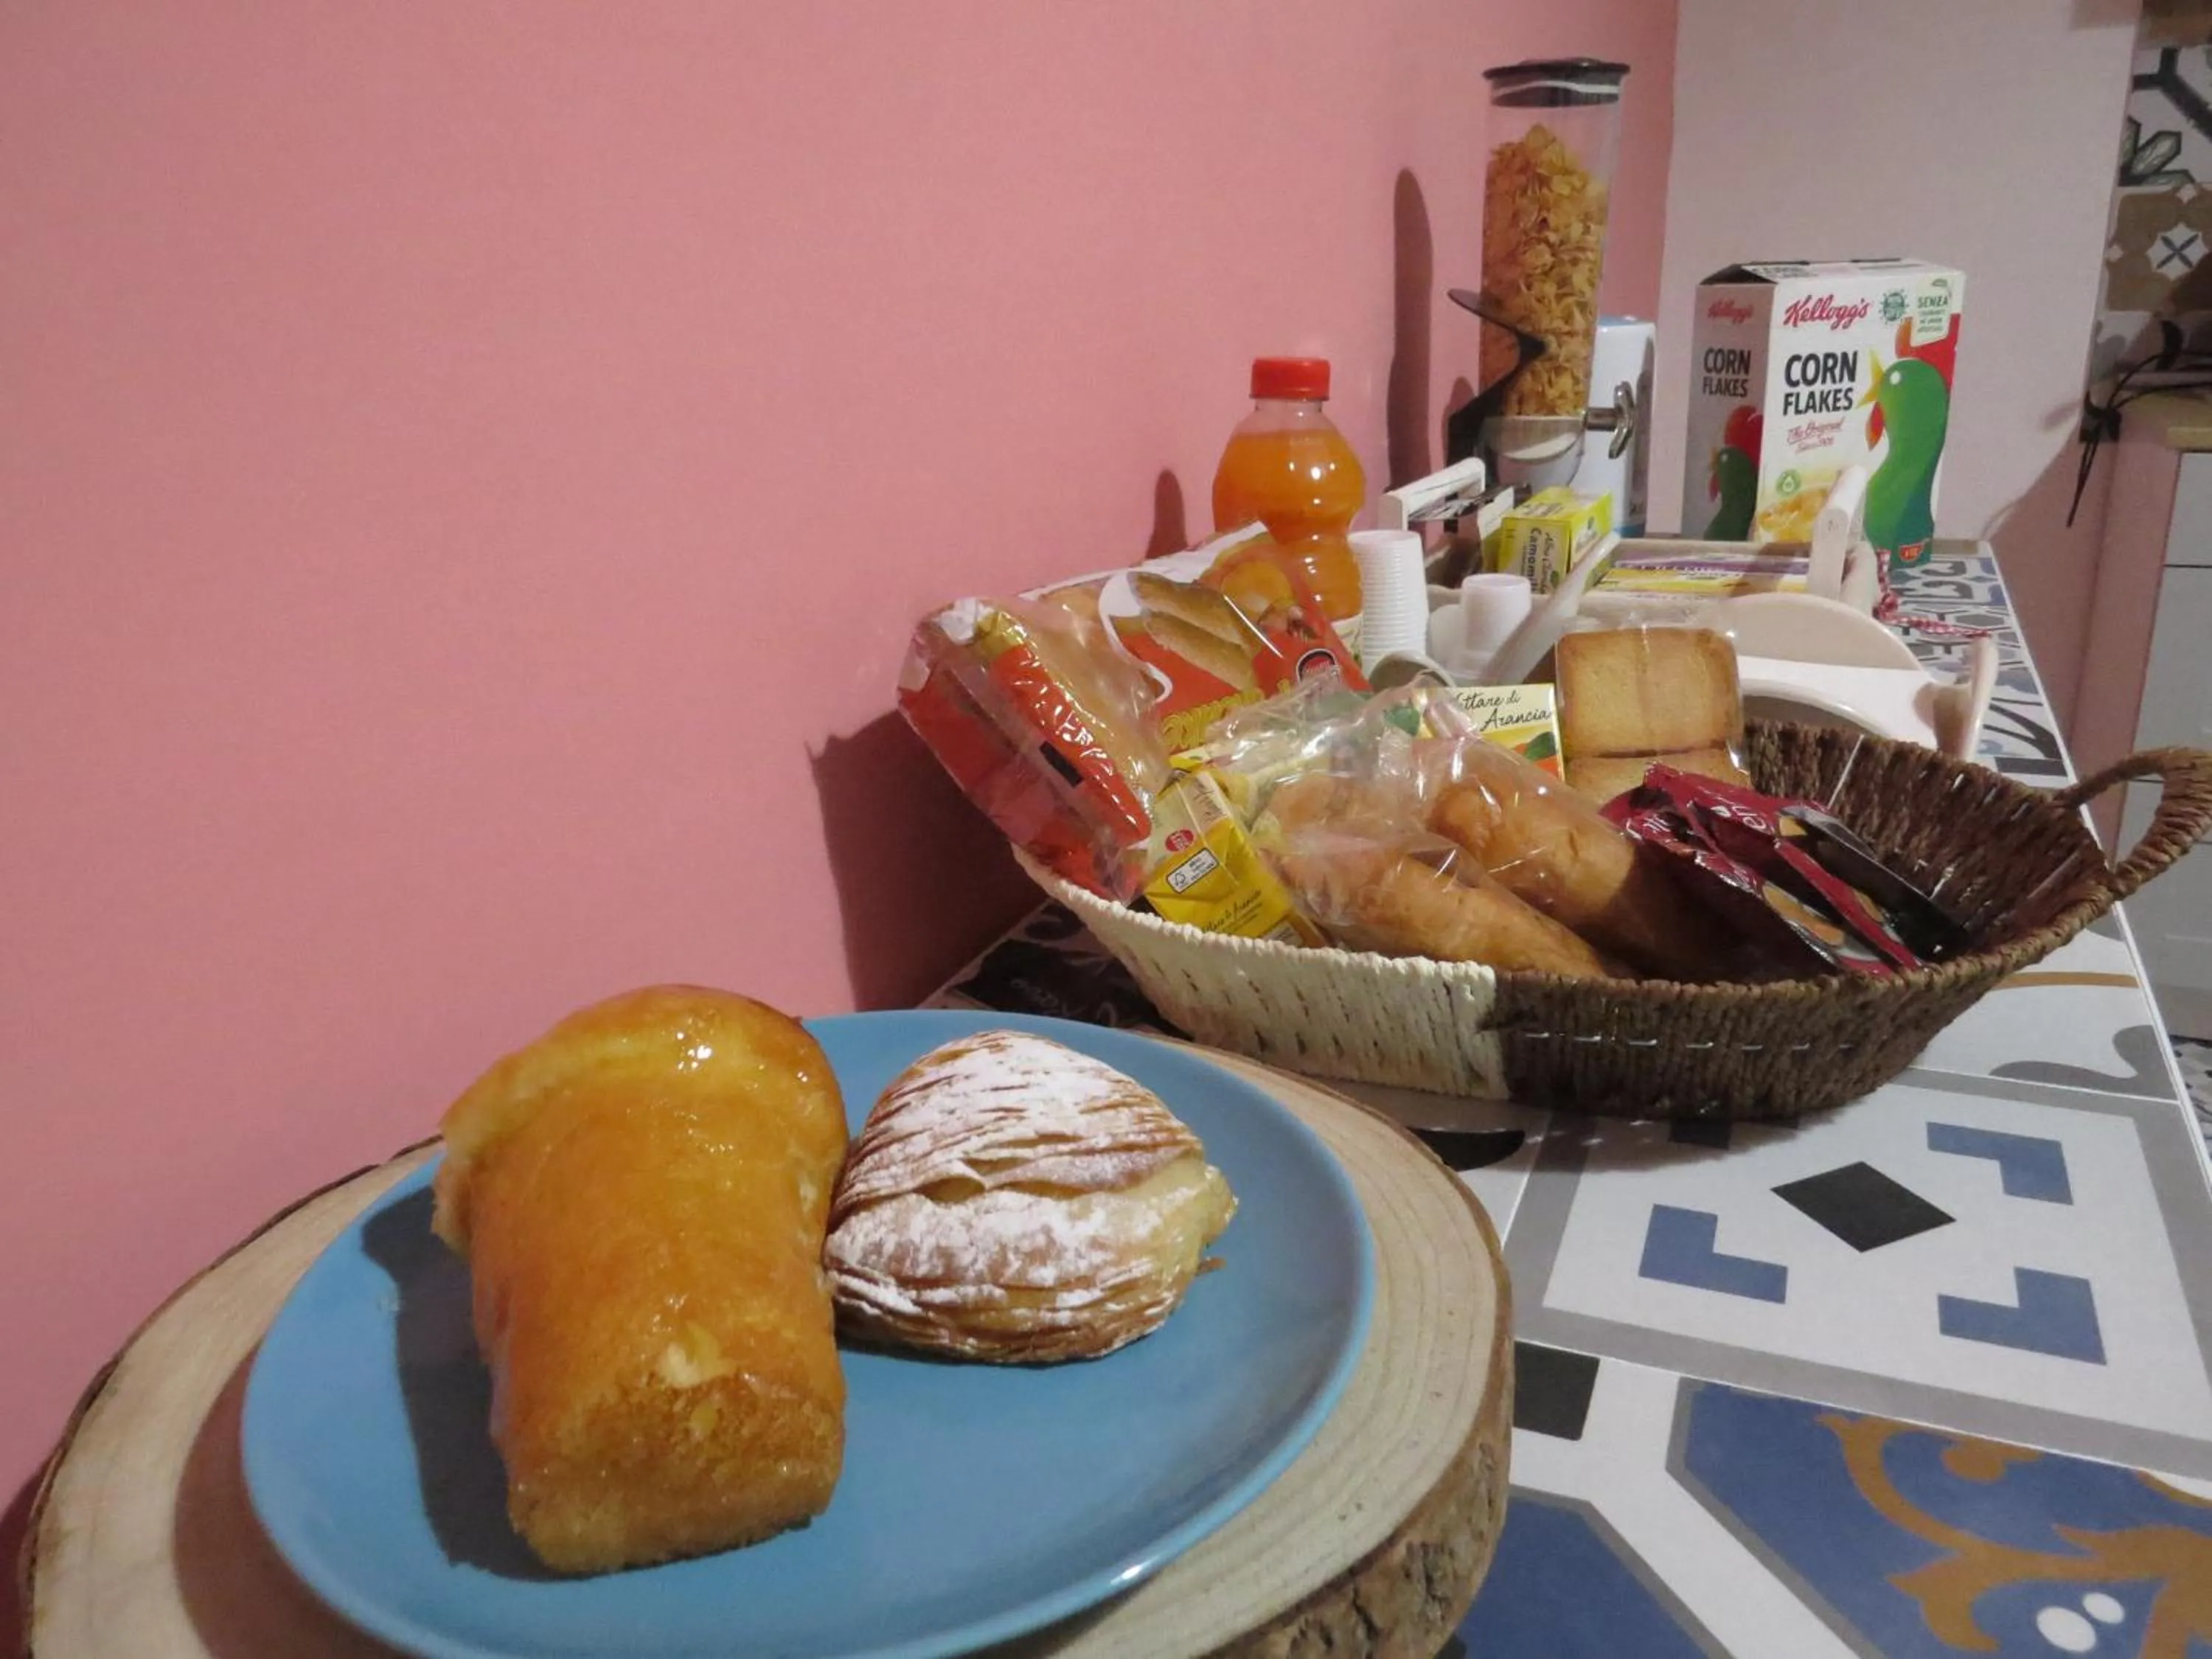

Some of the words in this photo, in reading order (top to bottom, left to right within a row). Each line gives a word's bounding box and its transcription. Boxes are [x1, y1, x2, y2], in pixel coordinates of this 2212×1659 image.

[1783, 294, 1871, 330] Kellogg's
[1704, 347, 1752, 376] CORN
[1784, 350, 1858, 388] CORN
[1703, 376, 1749, 398] FLAKES
[1783, 387, 1854, 417] FLAKES
[1480, 708, 1552, 731] Arancia
